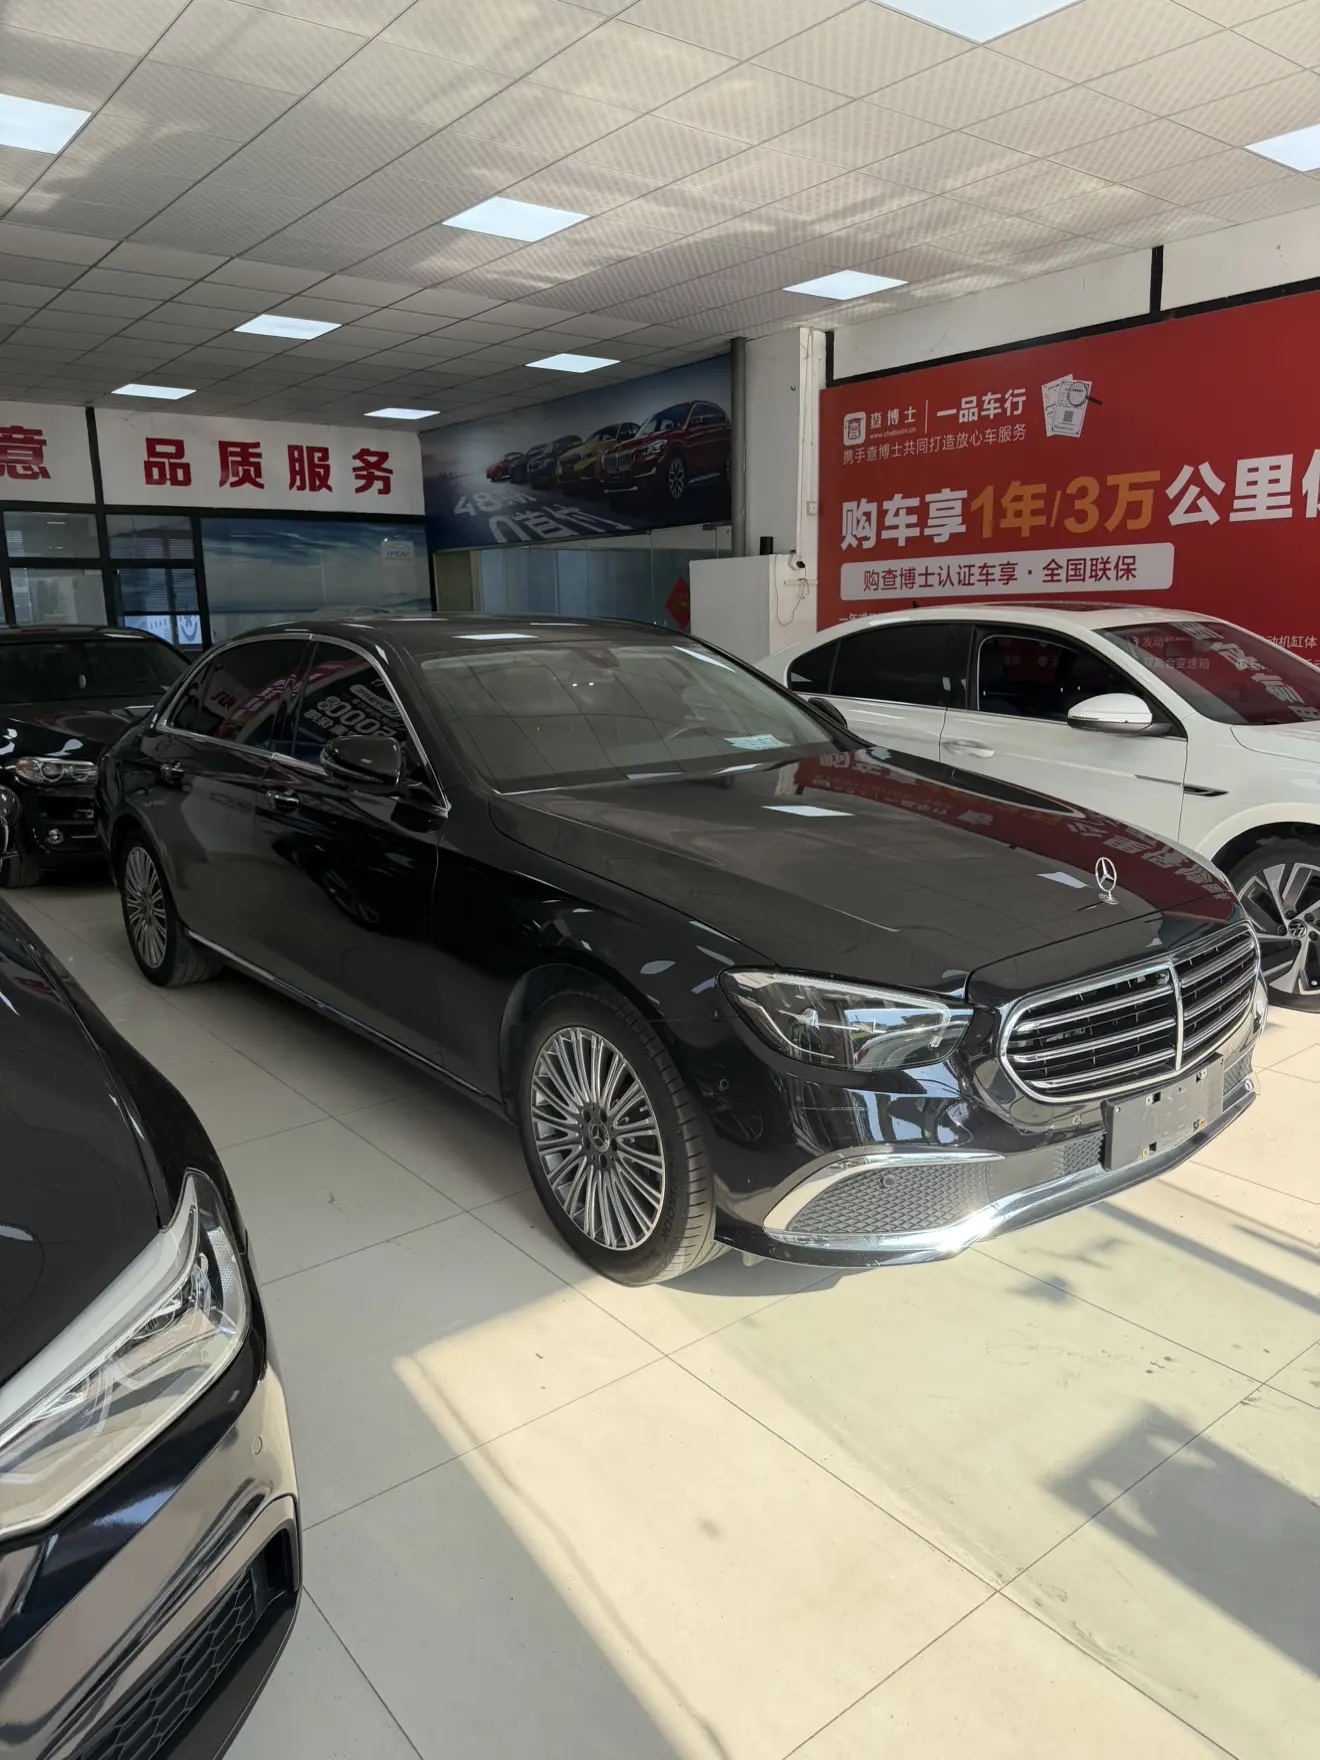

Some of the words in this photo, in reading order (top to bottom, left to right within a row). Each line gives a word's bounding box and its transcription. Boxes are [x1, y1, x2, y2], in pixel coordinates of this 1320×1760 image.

[936, 388, 1027, 423] 一品车行
[0, 425, 51, 480] 意
[843, 422, 1028, 465] 携手查博士共同打造放心车服务
[144, 436, 395, 496] 品质服务
[1262, 634, 1317, 649] 动机缸体
